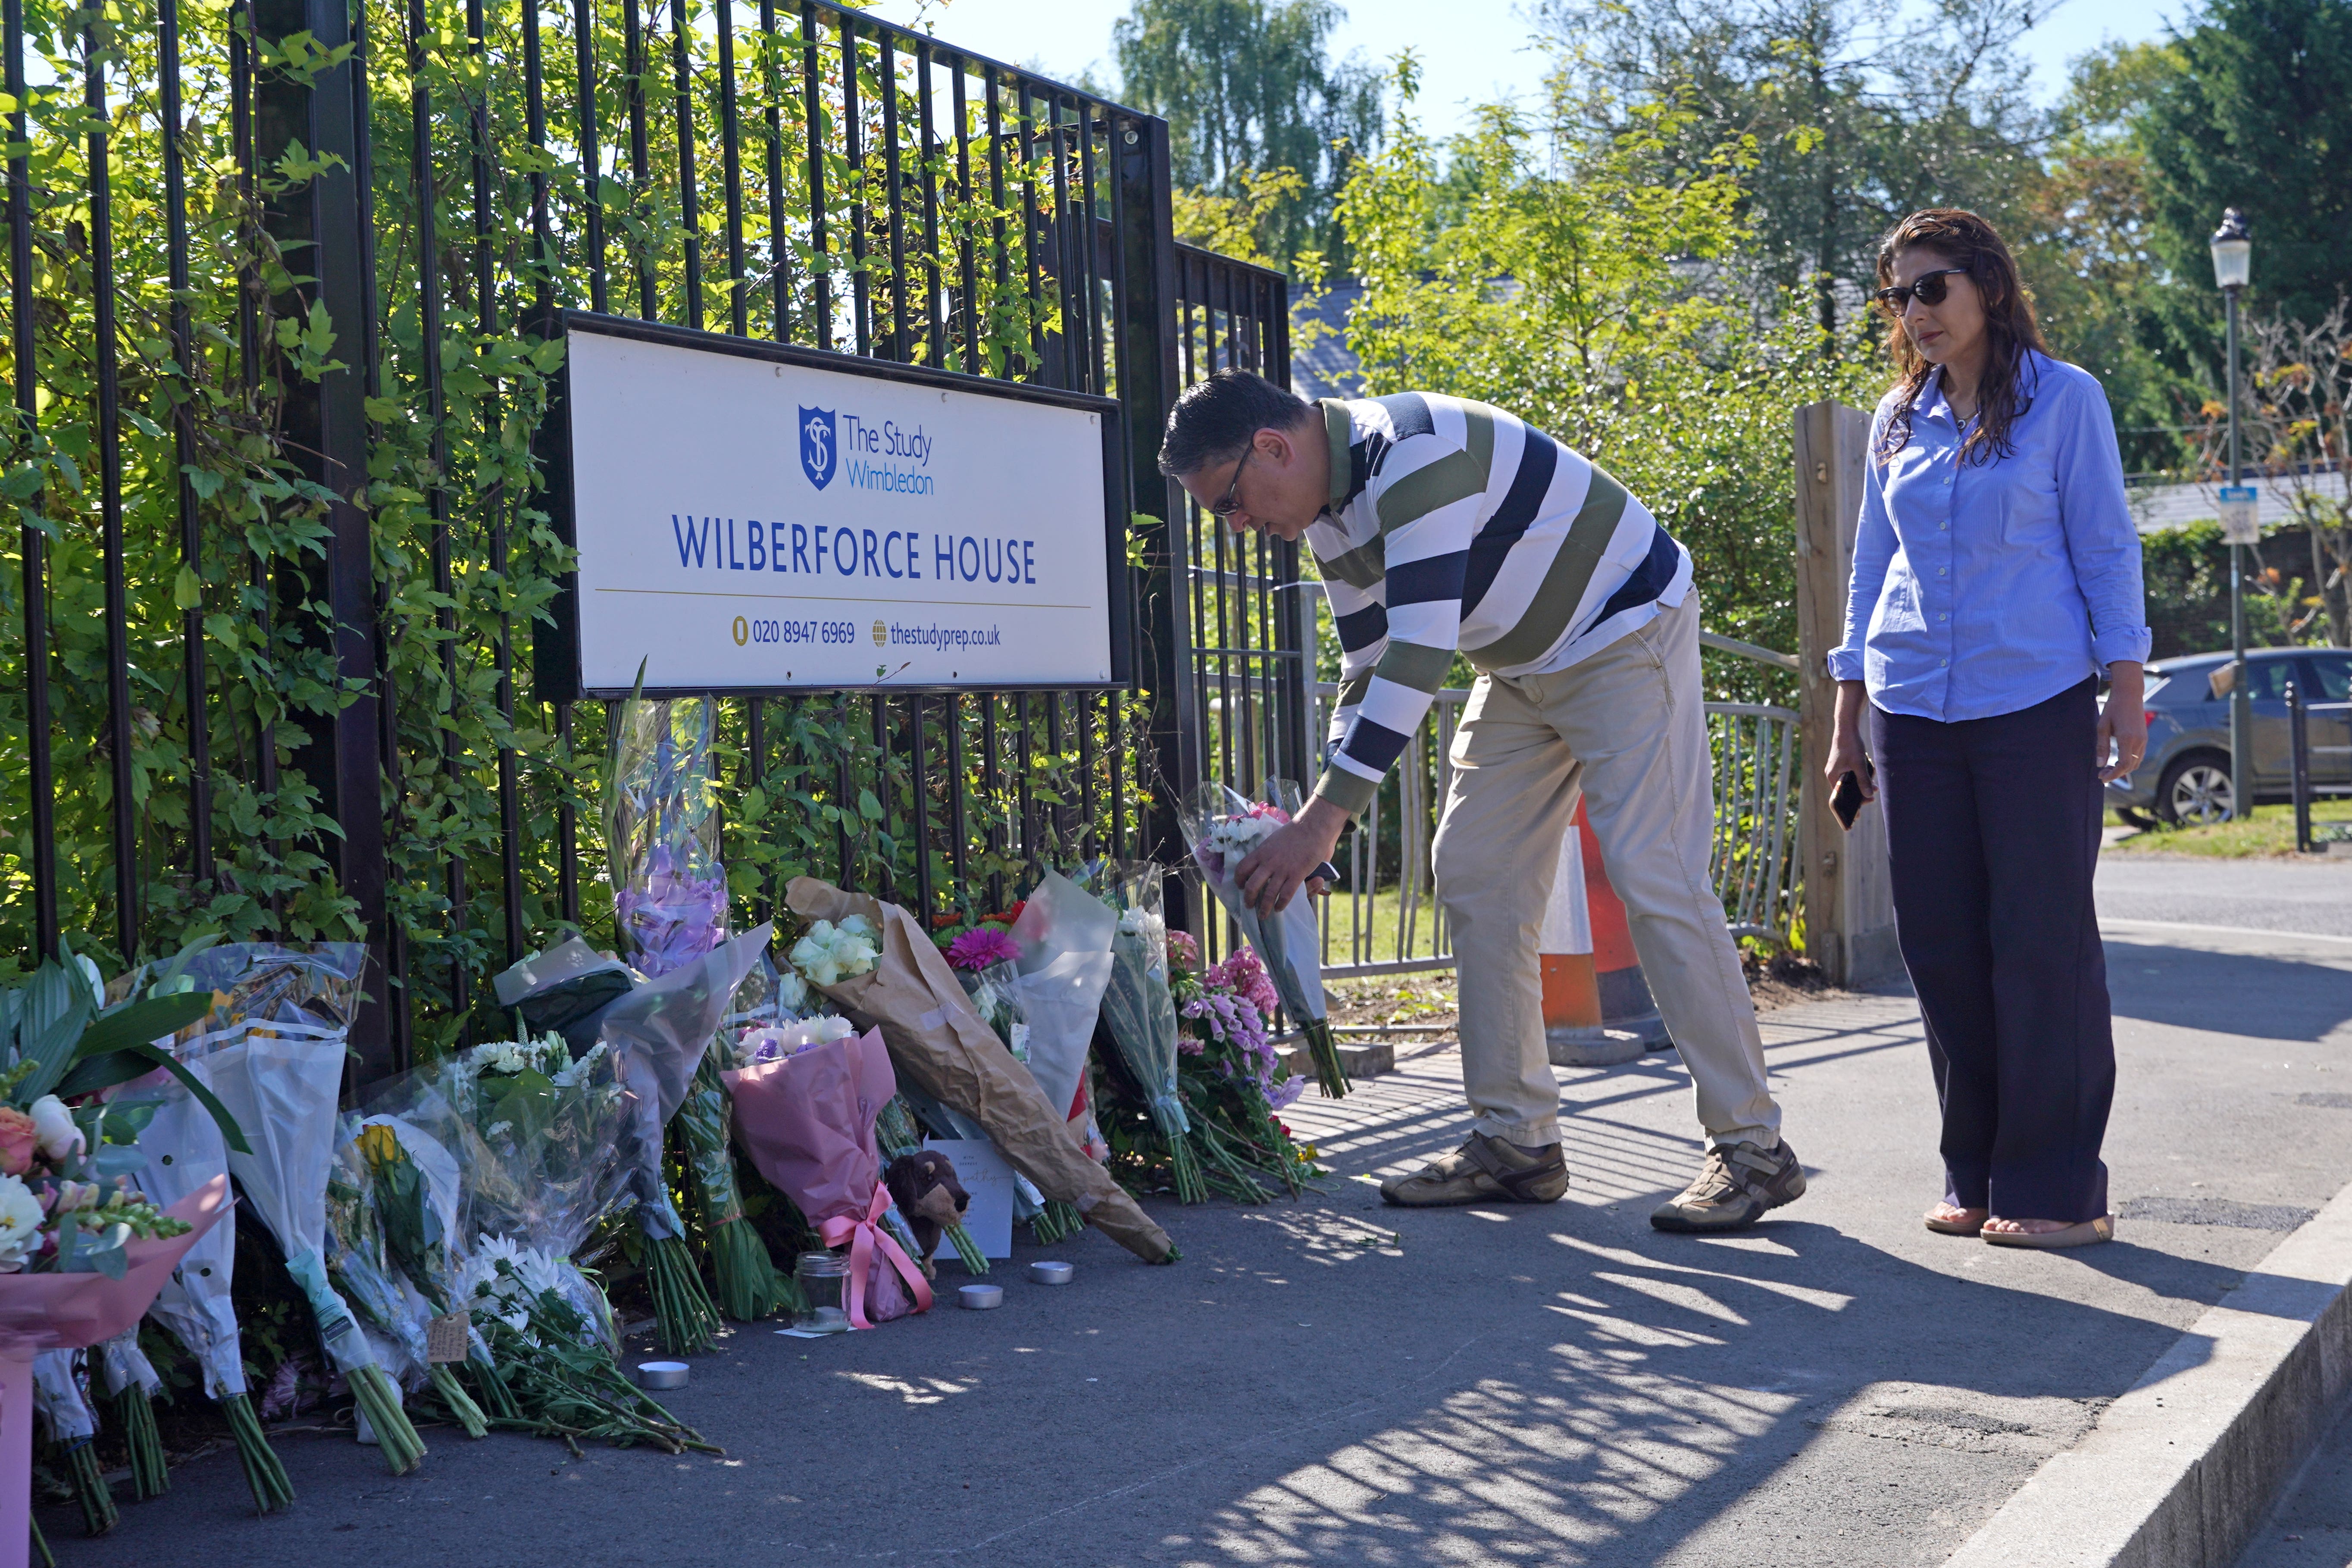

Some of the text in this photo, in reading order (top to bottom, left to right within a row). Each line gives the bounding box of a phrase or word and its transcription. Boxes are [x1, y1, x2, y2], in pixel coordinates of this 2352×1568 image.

[842, 414, 932, 467] The Study
[845, 458, 933, 495] Wimbledon
[671, 514, 1036, 584] WILBERFORCE HOUSE
[753, 620, 855, 644] 020 8947 6969
[890, 622, 1001, 652] thestudyprep.co.uk
